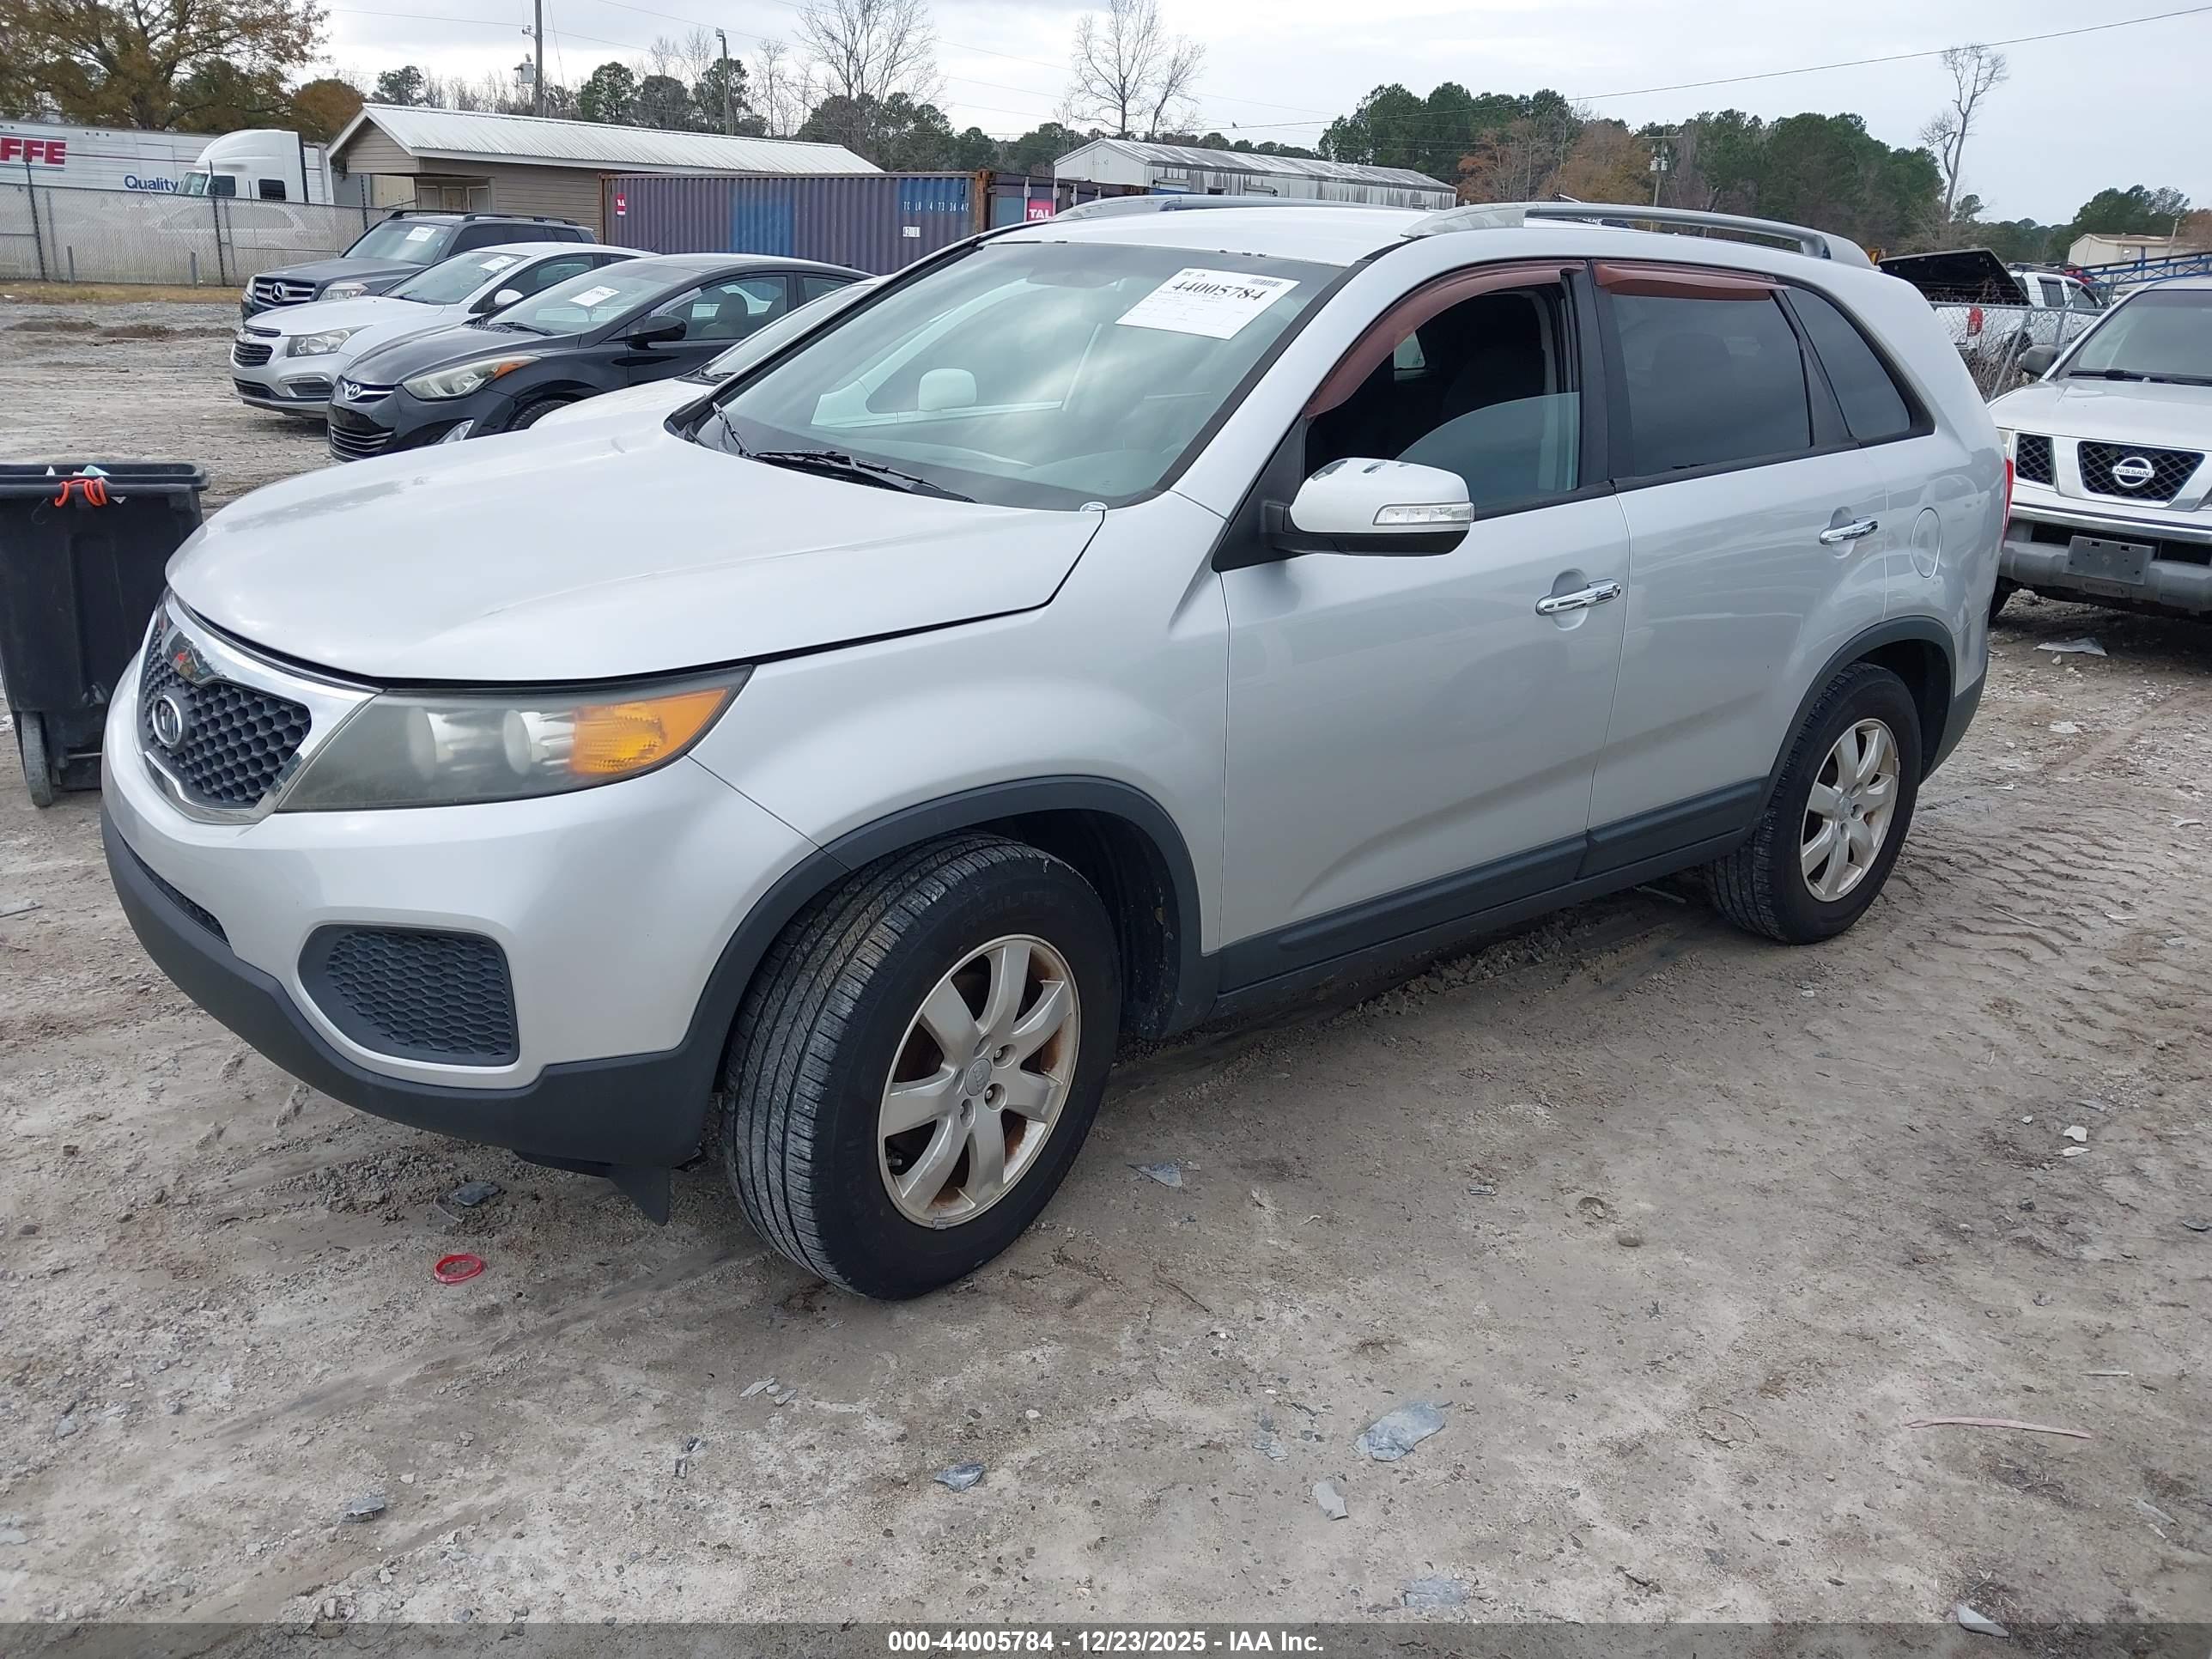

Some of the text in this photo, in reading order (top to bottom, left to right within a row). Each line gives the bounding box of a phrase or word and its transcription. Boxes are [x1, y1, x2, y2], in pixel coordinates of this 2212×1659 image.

[1, 137, 66, 165] FFE
[125, 174, 179, 193] Quality
[1028, 209, 1053, 219] TAL
[1171, 280, 1268, 301] 44005784
[2115, 467, 2151, 477] NISSAN
